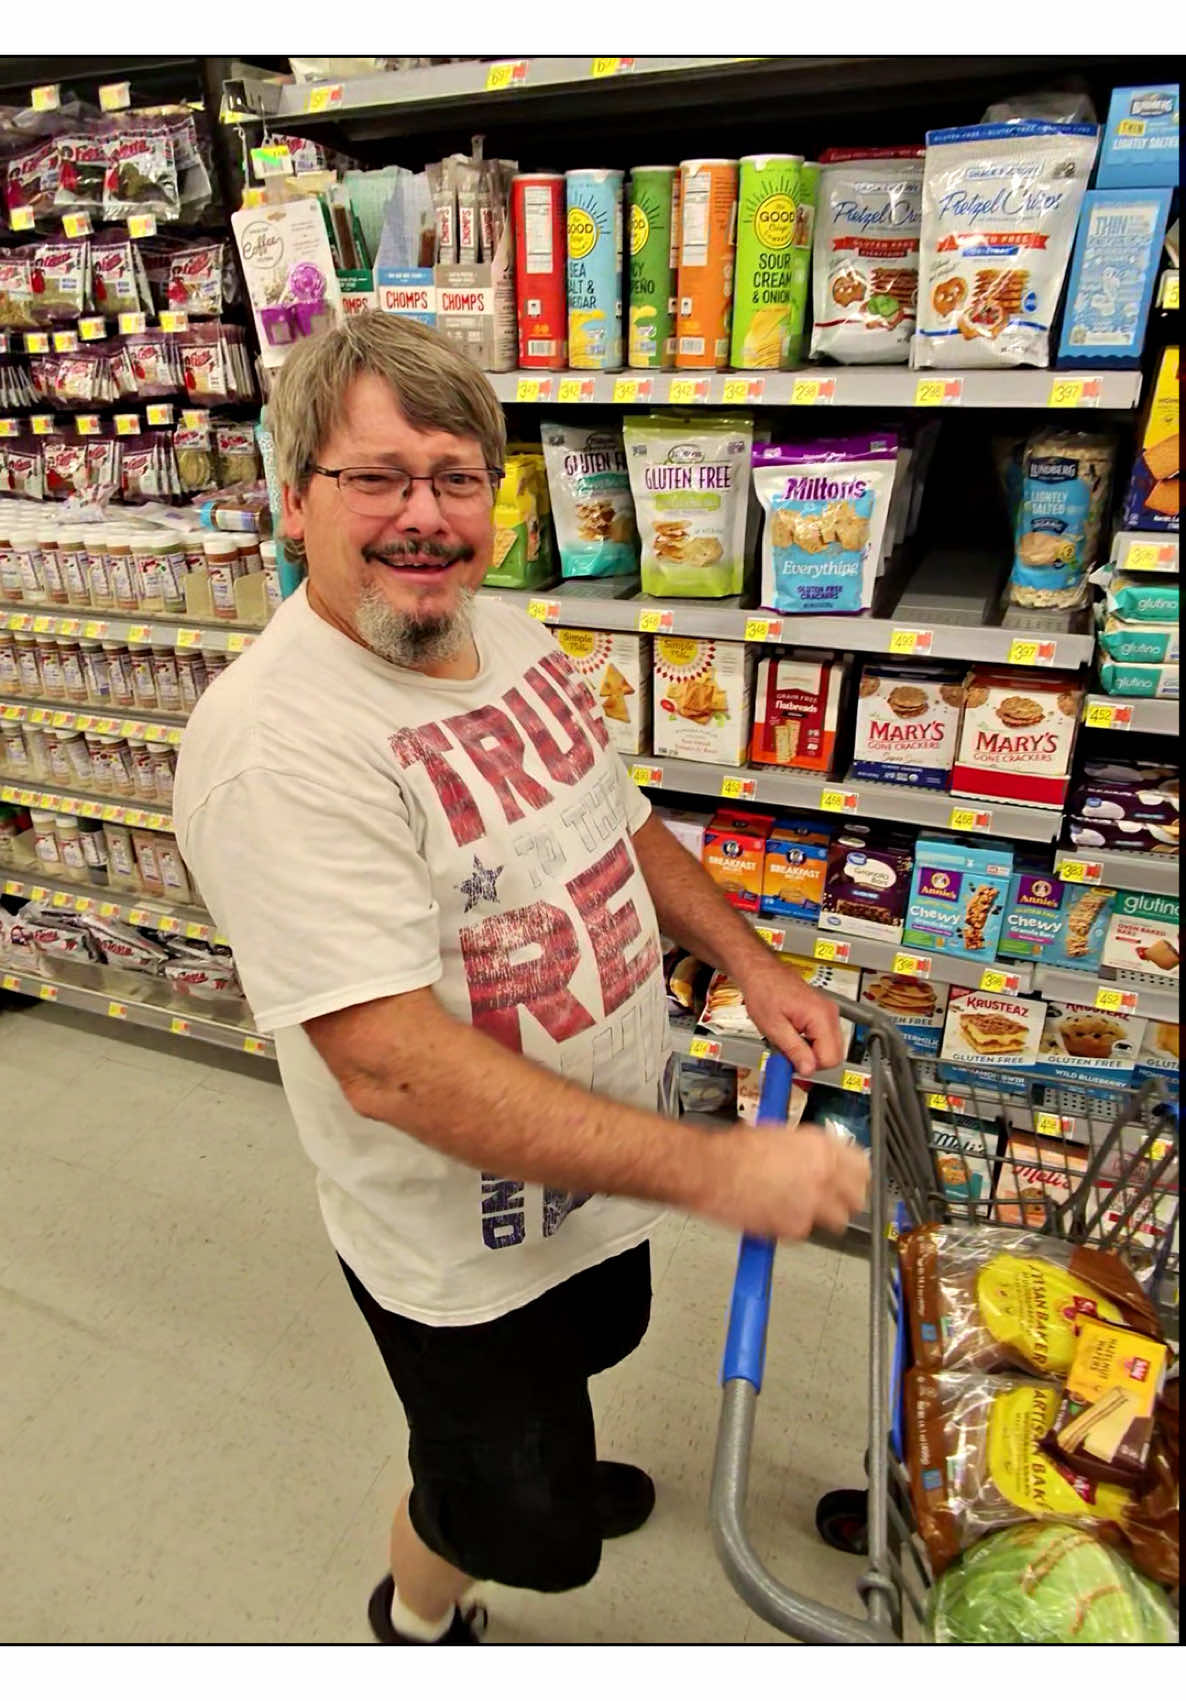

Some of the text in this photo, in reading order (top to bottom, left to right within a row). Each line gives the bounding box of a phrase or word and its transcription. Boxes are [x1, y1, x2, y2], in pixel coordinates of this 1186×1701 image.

[939, 188, 1002, 226] Pretzel
[760, 211, 795, 223] GOOD
[832, 200, 892, 233] Pretzel
[759, 253, 791, 269] SOUR
[567, 280, 595, 295] ALT &
[753, 272, 792, 289] CREAM
[386, 290, 429, 310] CHOMPS
[441, 292, 485, 312] CHOMPS
[752, 290, 792, 304] & ONION
[1055, 384, 1080, 402] 397
[564, 451, 611, 476] GLUTEN
[644, 465, 733, 490] GLUTEN FREE
[1031, 503, 1065, 515] SALTED
[782, 560, 860, 579] Everything
[1137, 598, 1179, 612] glutino
[563, 632, 594, 644] Simple
[663, 639, 695, 651] Simple
[1013, 642, 1037, 660] 397
[1120, 641, 1161, 656] glutino
[1115, 676, 1154, 690] glutino
[1089, 706, 1112, 722] 452
[868, 719, 945, 742] MARY'S
[387, 650, 609, 848] TRUE
[867, 741, 940, 751] GONE CRACKERS
[975, 730, 1058, 754] MARY'S
[973, 752, 1052, 763] GONE CRACKERS
[708, 855, 757, 872] BREAKFAST
[770, 863, 821, 880] BREAKFAST
[920, 885, 957, 900] Annie's
[1020, 894, 1058, 909] Annie's
[909, 904, 962, 925] Chewy
[1007, 914, 1063, 933] Chewy
[817, 942, 835, 958] 272
[1098, 991, 1119, 1004] 452
[966, 996, 1029, 1018] KRUSTEAZ
[907, 1017, 934, 1026] FREE
[902, 1033, 940, 1048] TERMILK
[952, 1053, 1025, 1065] GLUTEN FREE
[1047, 1055, 1123, 1068] GLUTEN FREE
[1146, 1058, 1179, 1070] GLUT
[1055, 1068, 1077, 1079] WILD
[1078, 1073, 1129, 1088] BLUEBERRY
[481, 1172, 527, 1250] ND
